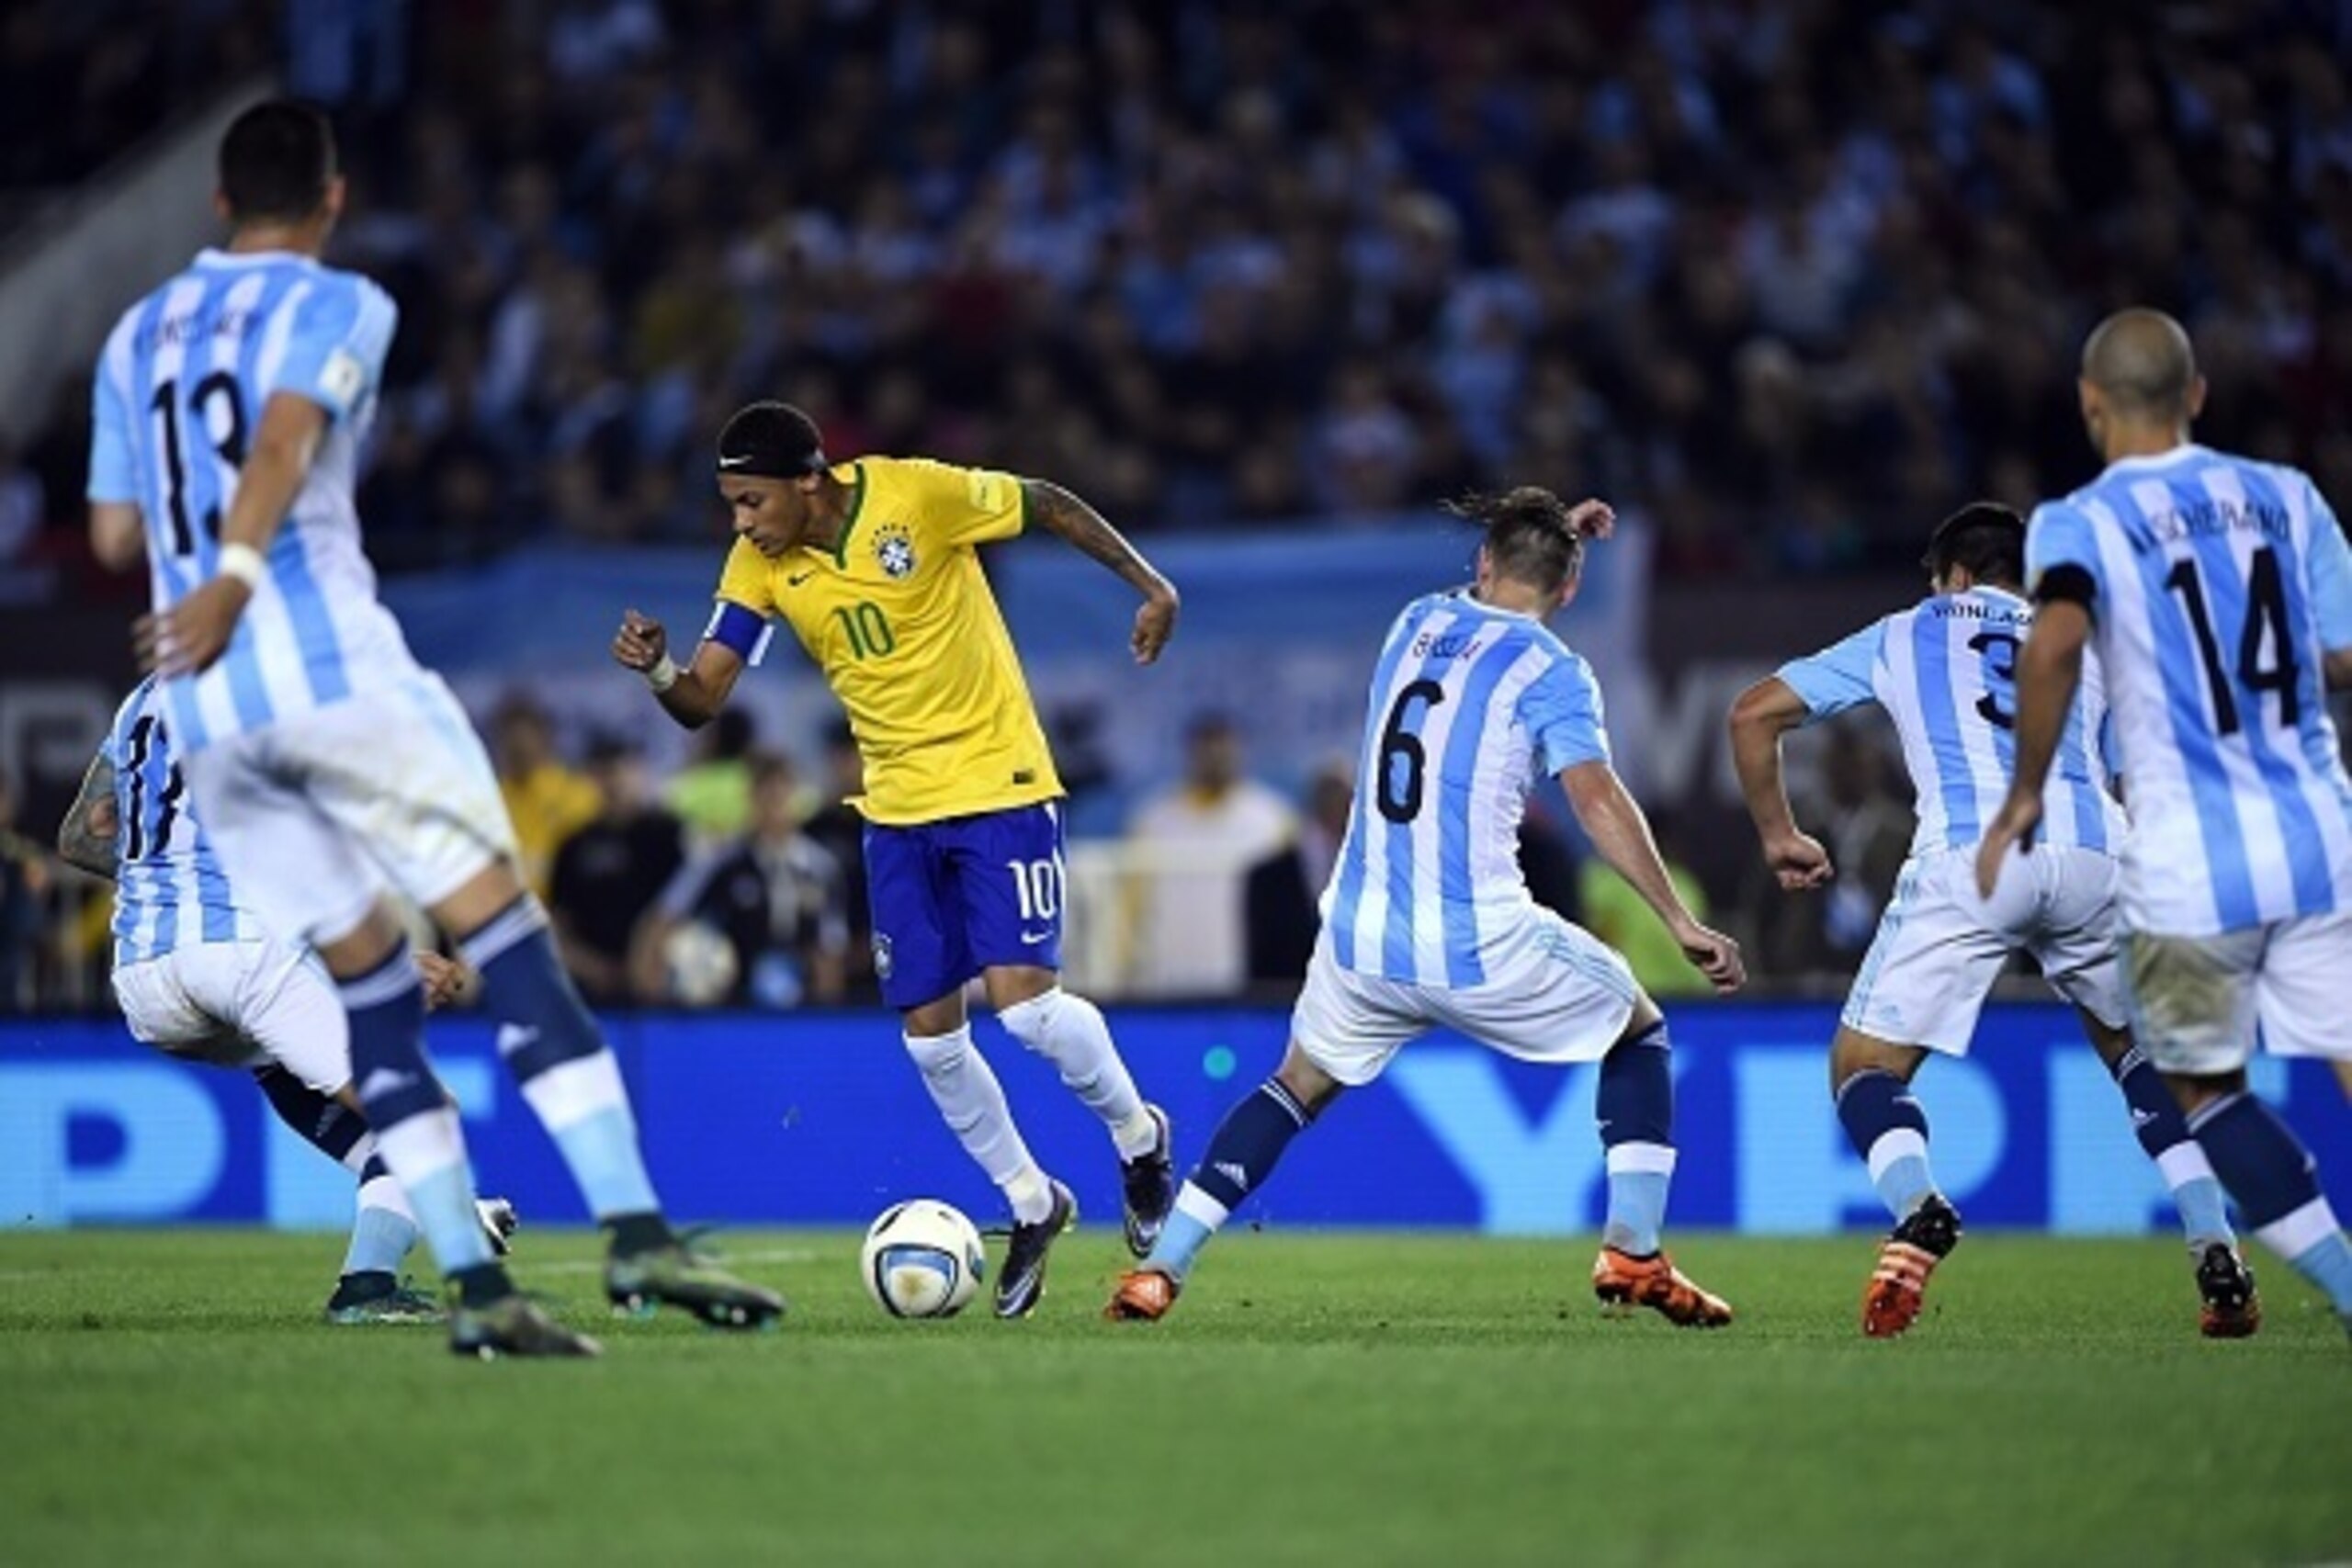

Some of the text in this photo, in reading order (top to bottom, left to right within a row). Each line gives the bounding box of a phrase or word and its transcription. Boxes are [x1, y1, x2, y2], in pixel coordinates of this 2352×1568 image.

[831, 601, 894, 660] 10
[2163, 547, 2300, 735] 14
[1967, 633, 2023, 730] 3
[1376, 680, 1445, 823] 6
[1006, 858, 1057, 919] 10
